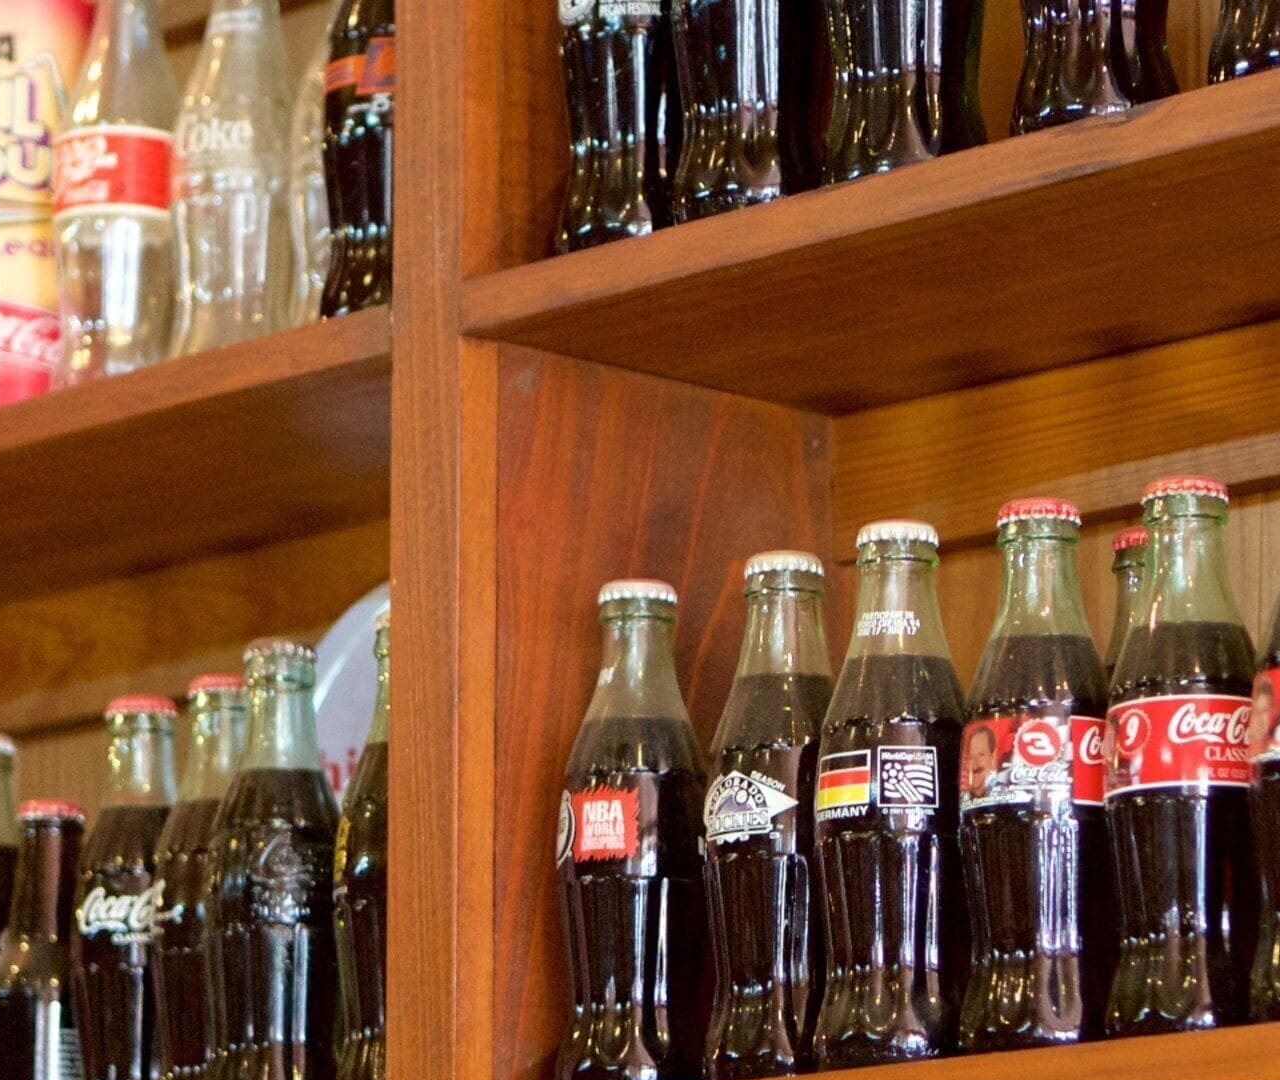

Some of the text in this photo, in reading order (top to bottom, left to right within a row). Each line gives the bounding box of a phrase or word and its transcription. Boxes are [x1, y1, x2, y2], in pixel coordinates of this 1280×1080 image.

[1125, 715, 1139, 746] 9
[1022, 732, 1055, 757] 3
[750, 769, 786, 793] SEASON
[582, 799, 625, 823] NBA
[816, 805, 869, 822] GERMANY
[582, 822, 625, 837] WORLD
